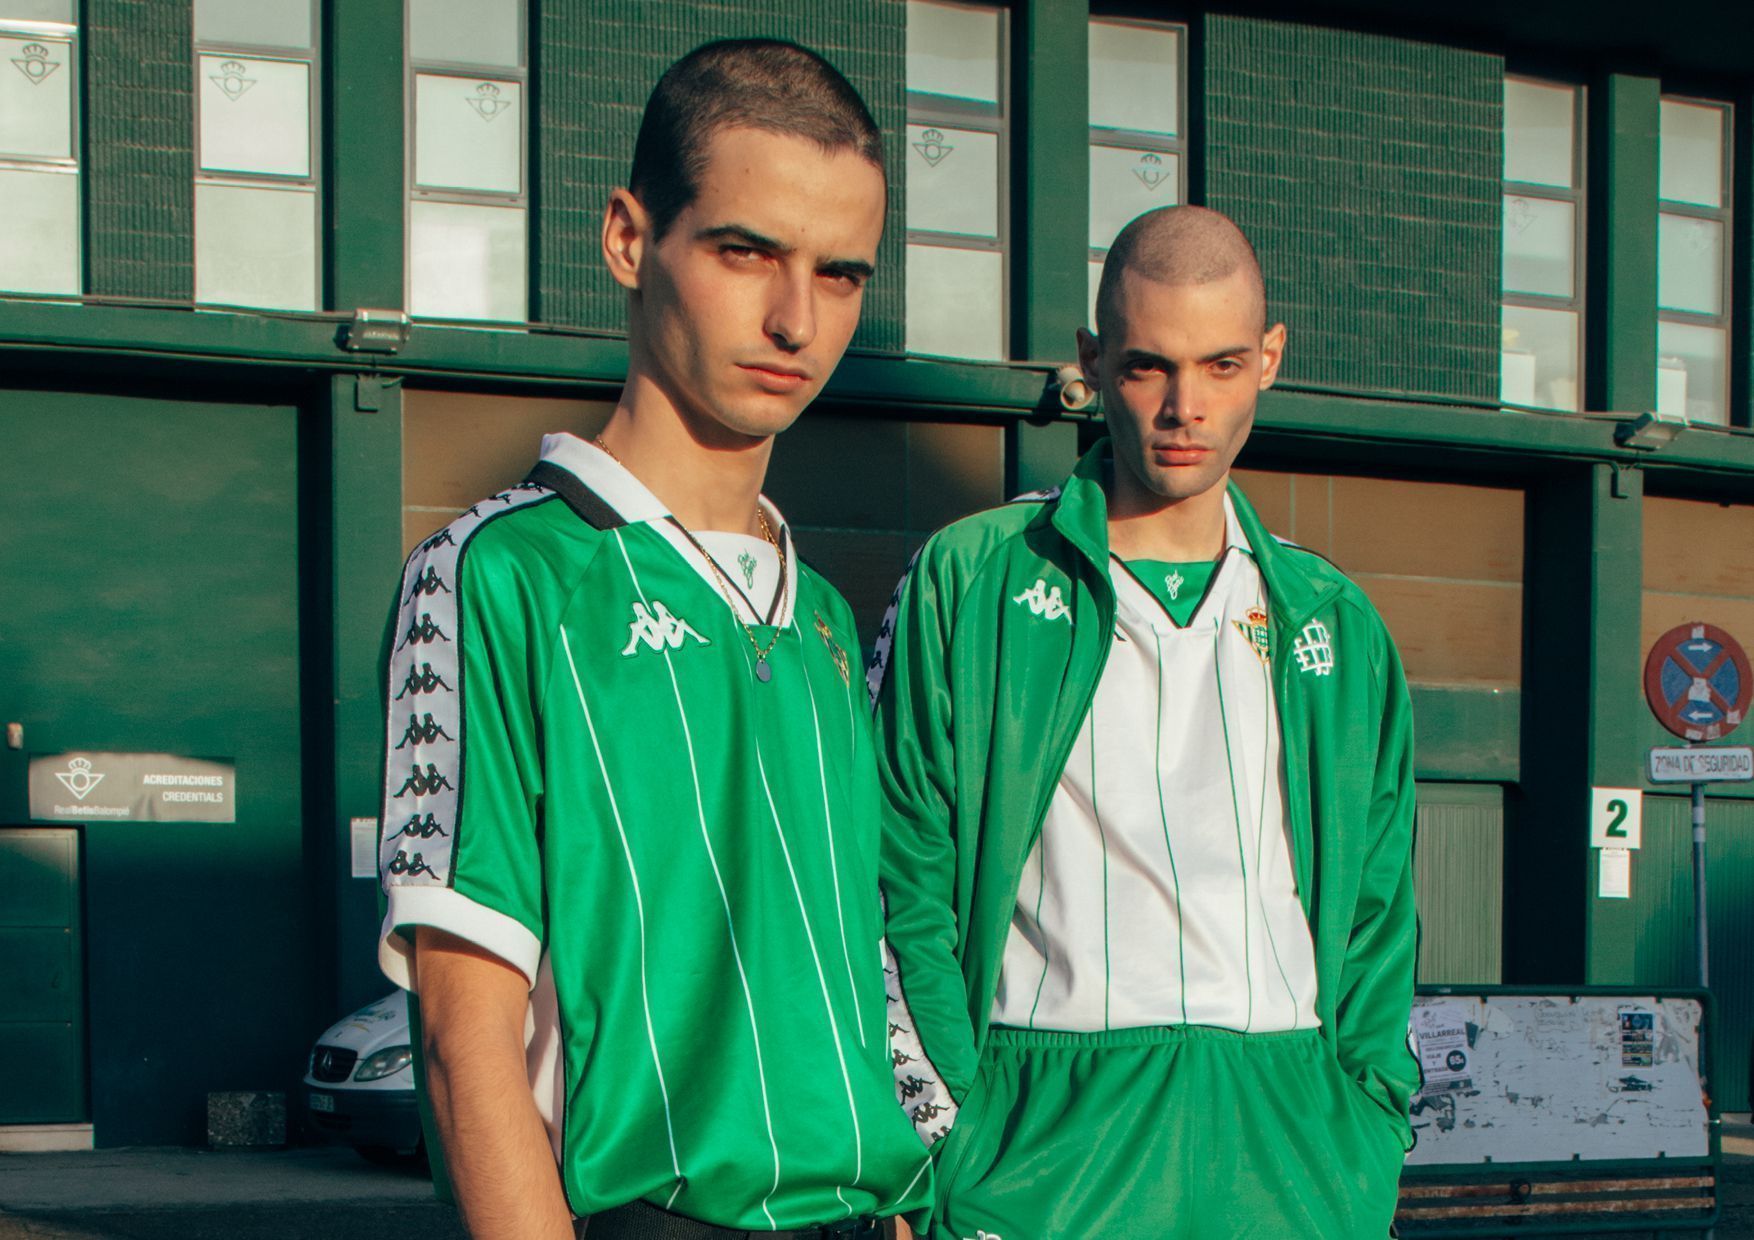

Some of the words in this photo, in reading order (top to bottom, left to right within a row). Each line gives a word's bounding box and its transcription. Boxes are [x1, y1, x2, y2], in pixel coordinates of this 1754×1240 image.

[1699, 754, 1750, 772] SEGURIDAD
[143, 774, 223, 787] ACREDITACIONES
[162, 791, 224, 803] CREDENTIALS
[1606, 799, 1627, 837] 2
[1419, 1028, 1466, 1040] VILLARREAL
